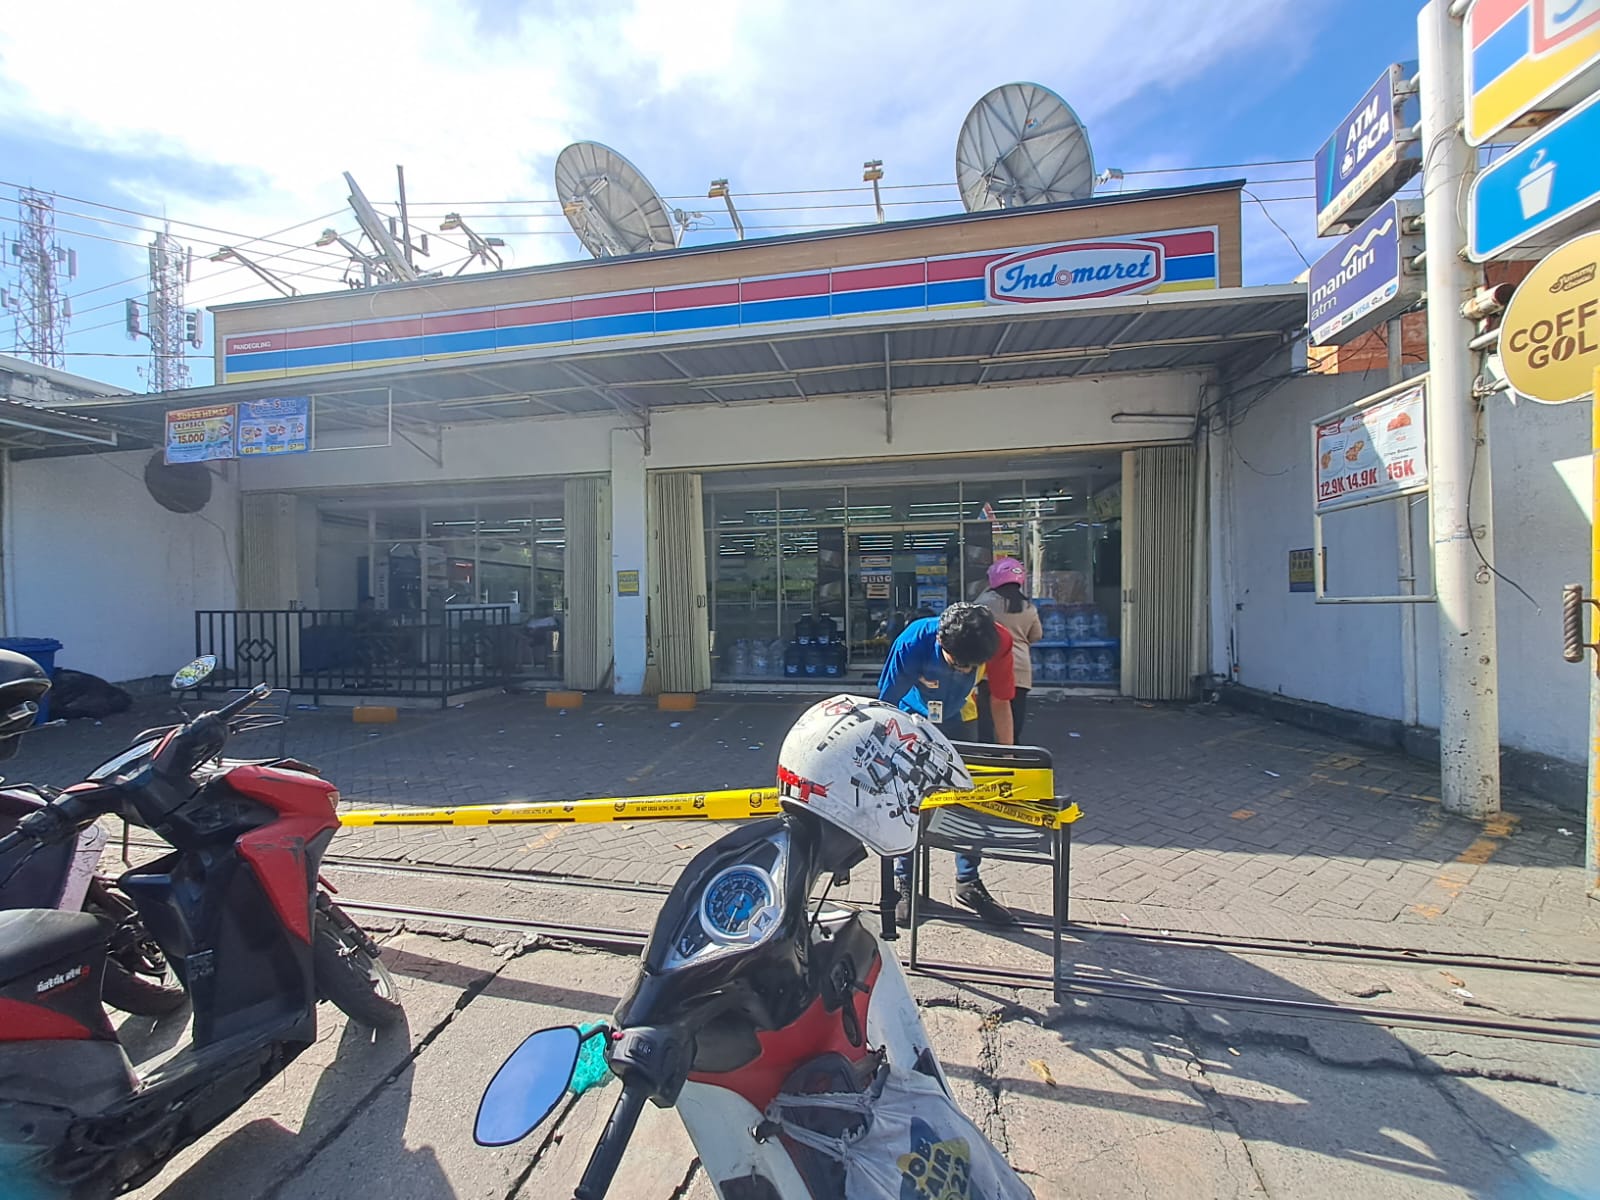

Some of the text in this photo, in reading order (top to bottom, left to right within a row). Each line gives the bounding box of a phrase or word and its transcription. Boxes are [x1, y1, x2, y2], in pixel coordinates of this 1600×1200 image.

[1346, 96, 1378, 149] ATM
[1356, 111, 1390, 163] BCA
[1000, 254, 1151, 292] Indomaret
[1311, 248, 1375, 305] mandiri
[1311, 293, 1337, 320] atm
[1320, 475, 1345, 496] 12.9K
[1346, 468, 1377, 490] 14.9K
[1386, 459, 1416, 480] 15K
